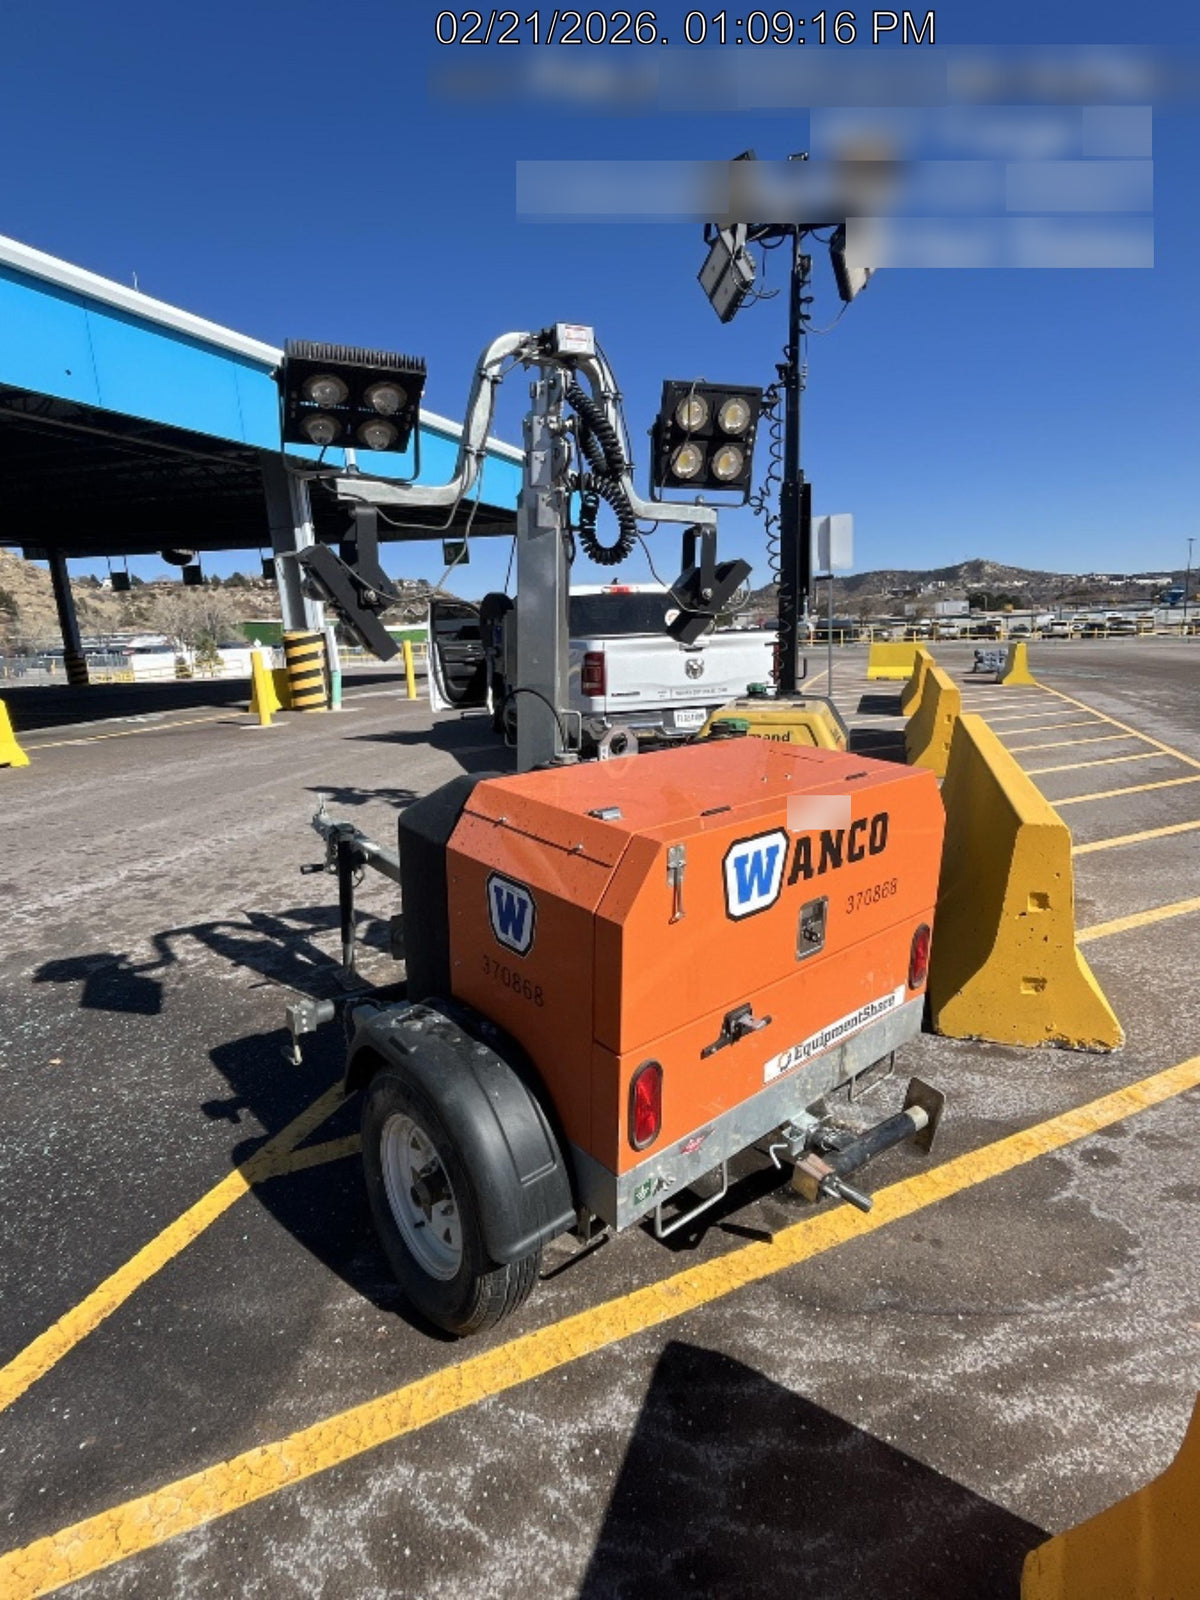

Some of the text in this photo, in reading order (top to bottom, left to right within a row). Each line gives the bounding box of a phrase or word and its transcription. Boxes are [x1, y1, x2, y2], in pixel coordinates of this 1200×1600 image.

[732, 812, 888, 906] WANCO
[845, 877, 897, 914] 370868
[482, 954, 544, 1008] 370868
[793, 995, 895, 1060] EquipmentShare
